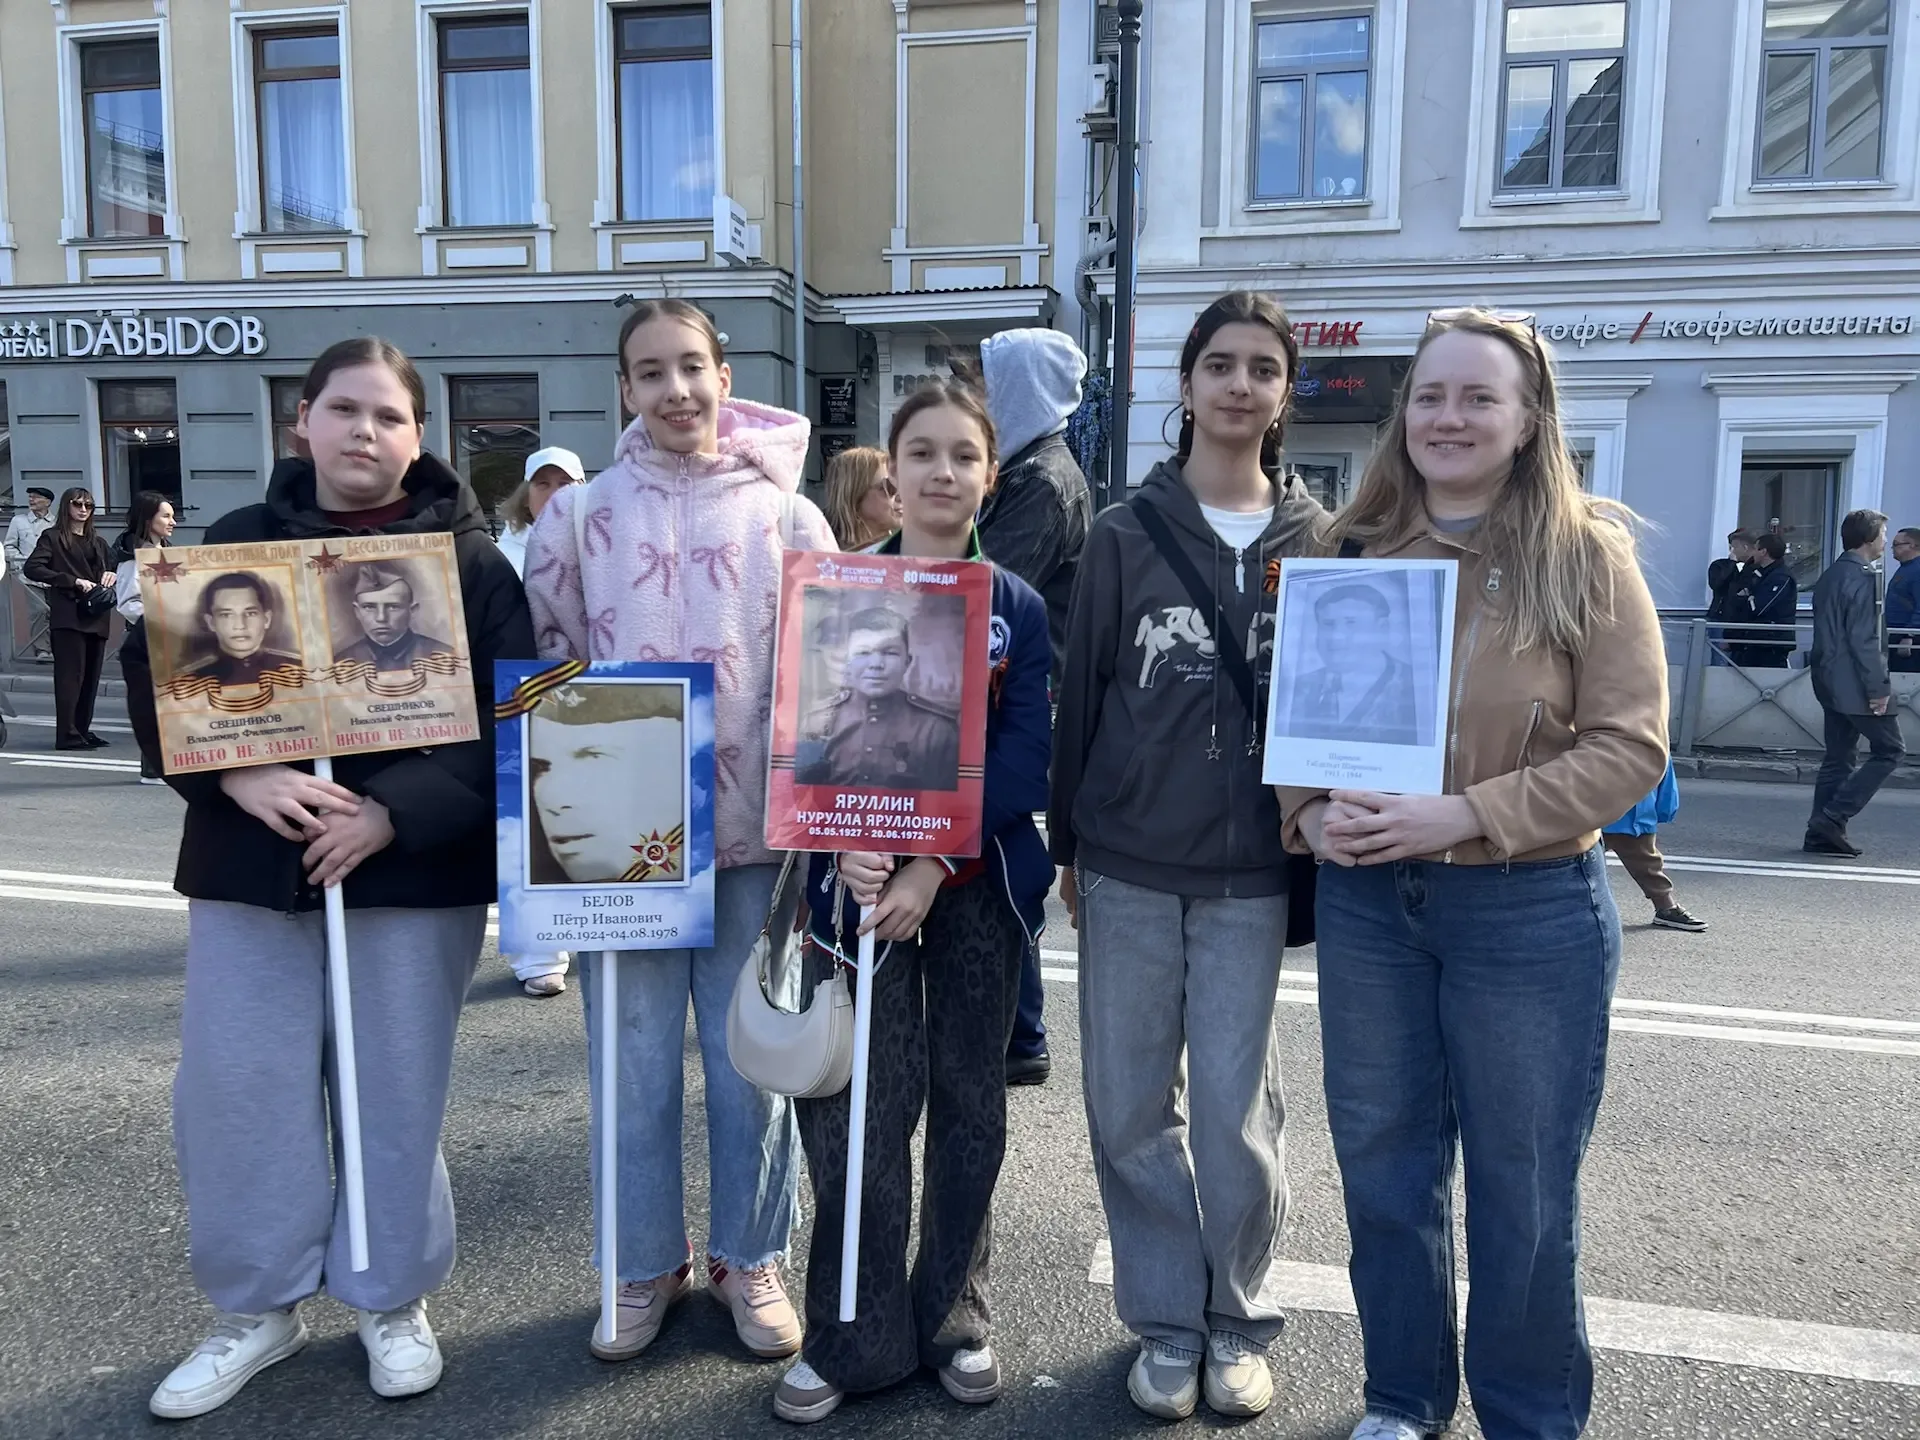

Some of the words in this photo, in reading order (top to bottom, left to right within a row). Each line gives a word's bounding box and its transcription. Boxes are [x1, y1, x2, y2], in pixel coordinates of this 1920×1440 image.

[1661, 310, 1914, 345] кофемашины
[1327, 375, 1366, 396] кофе
[903, 569, 918, 584] 80
[919, 573, 958, 586] ПОБЕДА!
[367, 700, 436, 714] СВЕШНИКОВ
[209, 713, 282, 730] СВЕШНИКОВ
[187, 731, 240, 745] Владимир
[336, 730, 381, 747] НИЧТО
[388, 728, 405, 742] НЕ
[173, 747, 227, 767] НИКТО
[236, 743, 256, 759] НЕ
[835, 793, 915, 812] ЯРУЛЛИН
[796, 811, 862, 826] НУРУЛЛА
[865, 813, 952, 831] ЯРУЛЛОВИЧ
[808, 826, 863, 838] 05.05.1927
[871, 829, 924, 841] 20.06.1972
[581, 894, 635, 908] БЕЛОВ
[552, 913, 589, 928] Пётр
[592, 913, 663, 925] Иванович
[536, 926, 679, 942] 02.06.1924-04.08.1978
